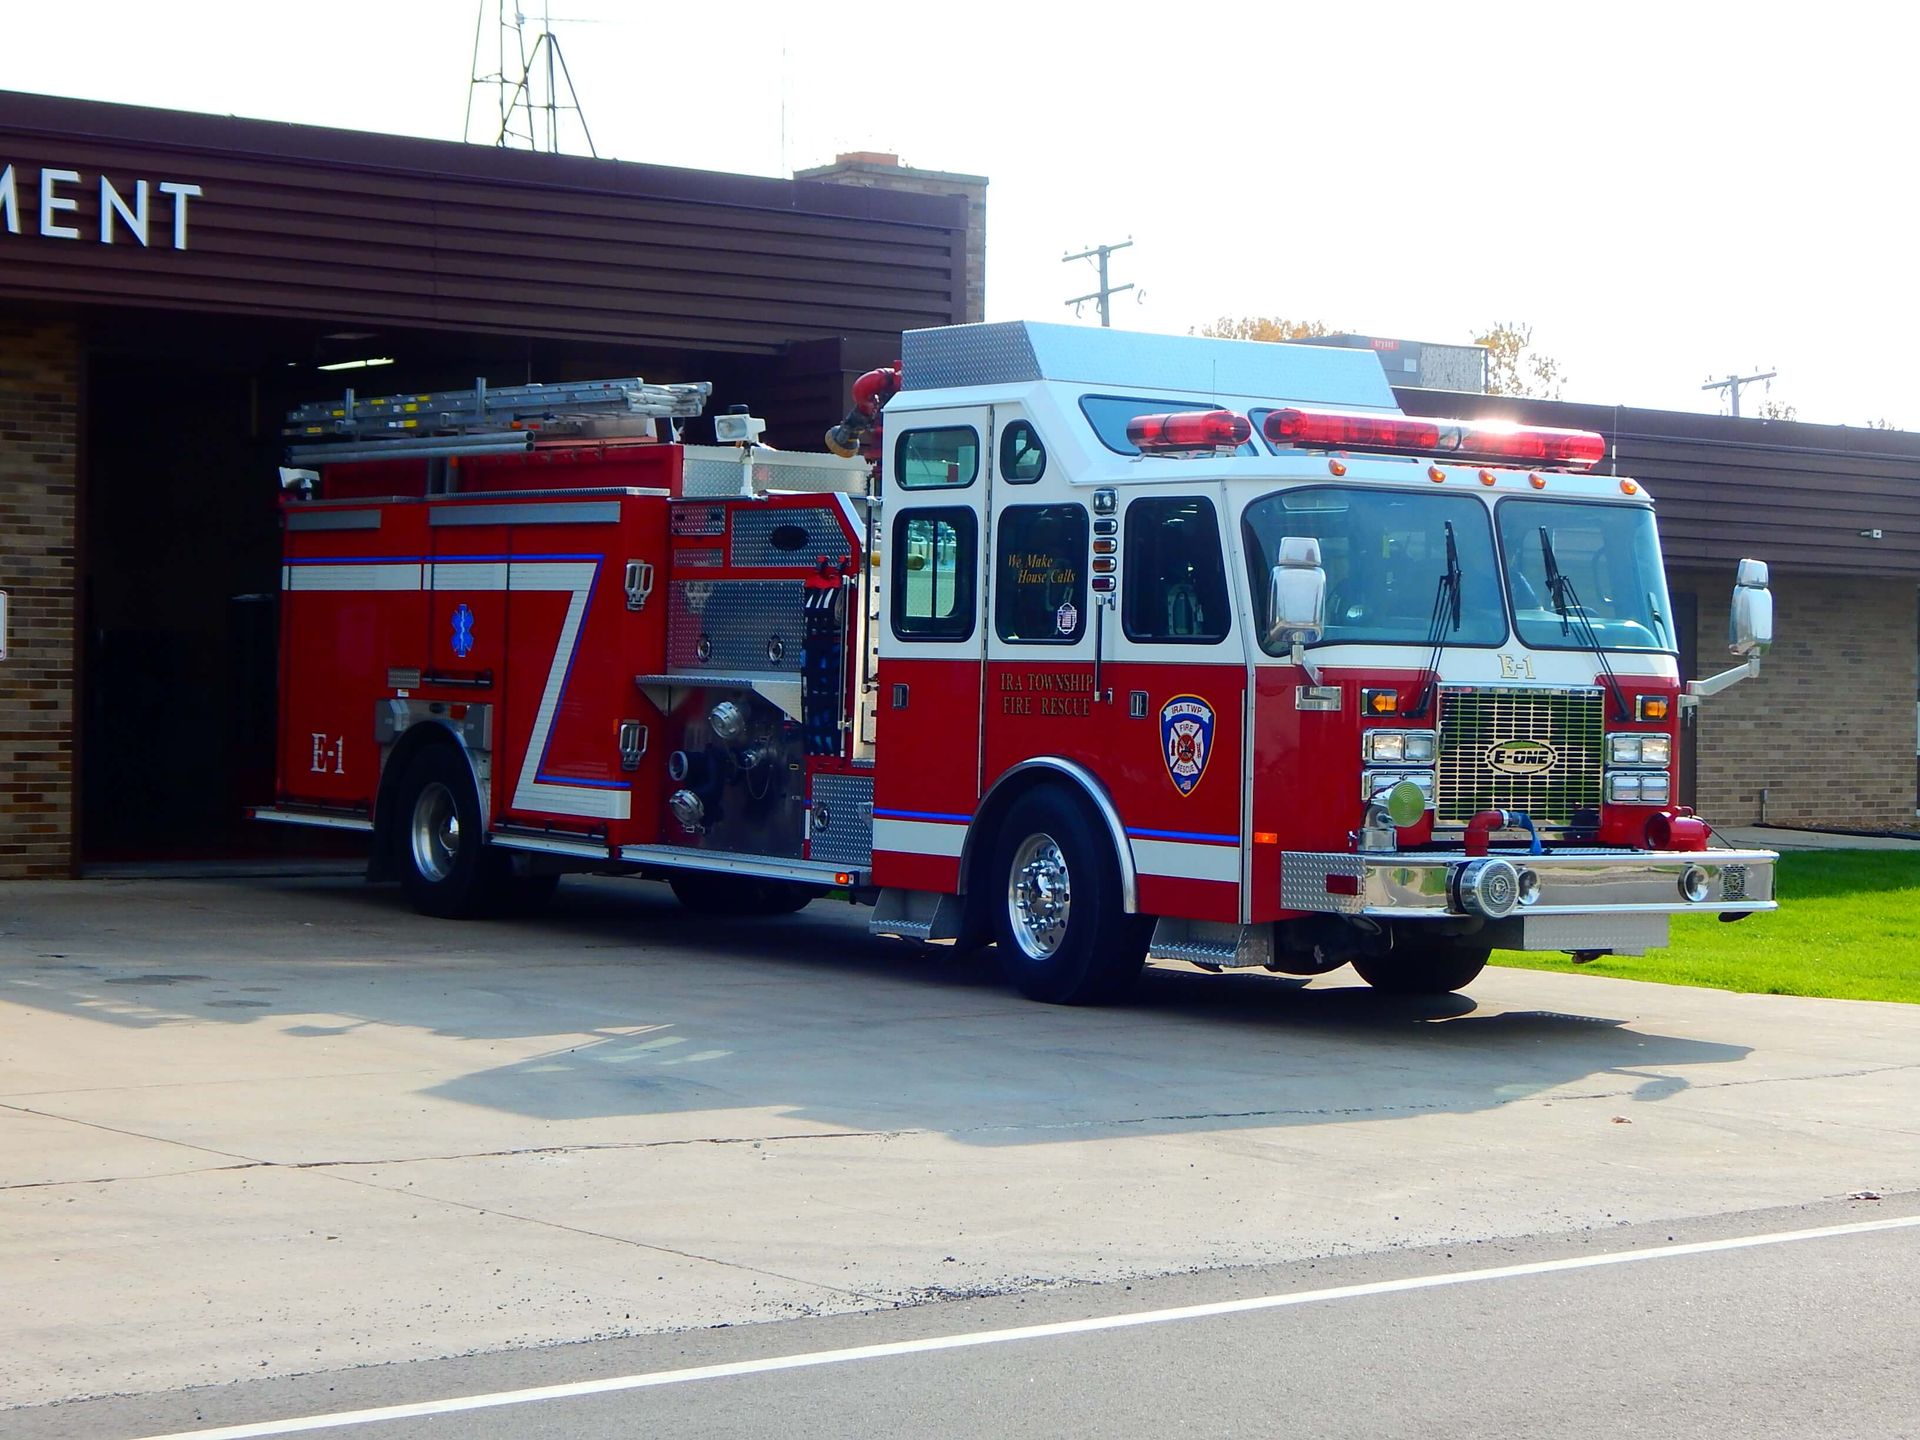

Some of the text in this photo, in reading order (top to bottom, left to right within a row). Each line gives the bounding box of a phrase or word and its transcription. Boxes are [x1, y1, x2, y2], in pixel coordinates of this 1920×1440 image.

[1008, 553, 1053, 568] We Make
[1018, 568, 1076, 584] House Calls
[1497, 653, 1537, 680] E-1
[1000, 673, 1093, 692] IRA TOWNSHIP
[1003, 696, 1090, 716] FIRE RESCUE
[1171, 705, 1184, 715] IRA
[1180, 723, 1194, 733] FIRE
[310, 733, 345, 774] E-1
[1494, 750, 1549, 764] E-ONE
